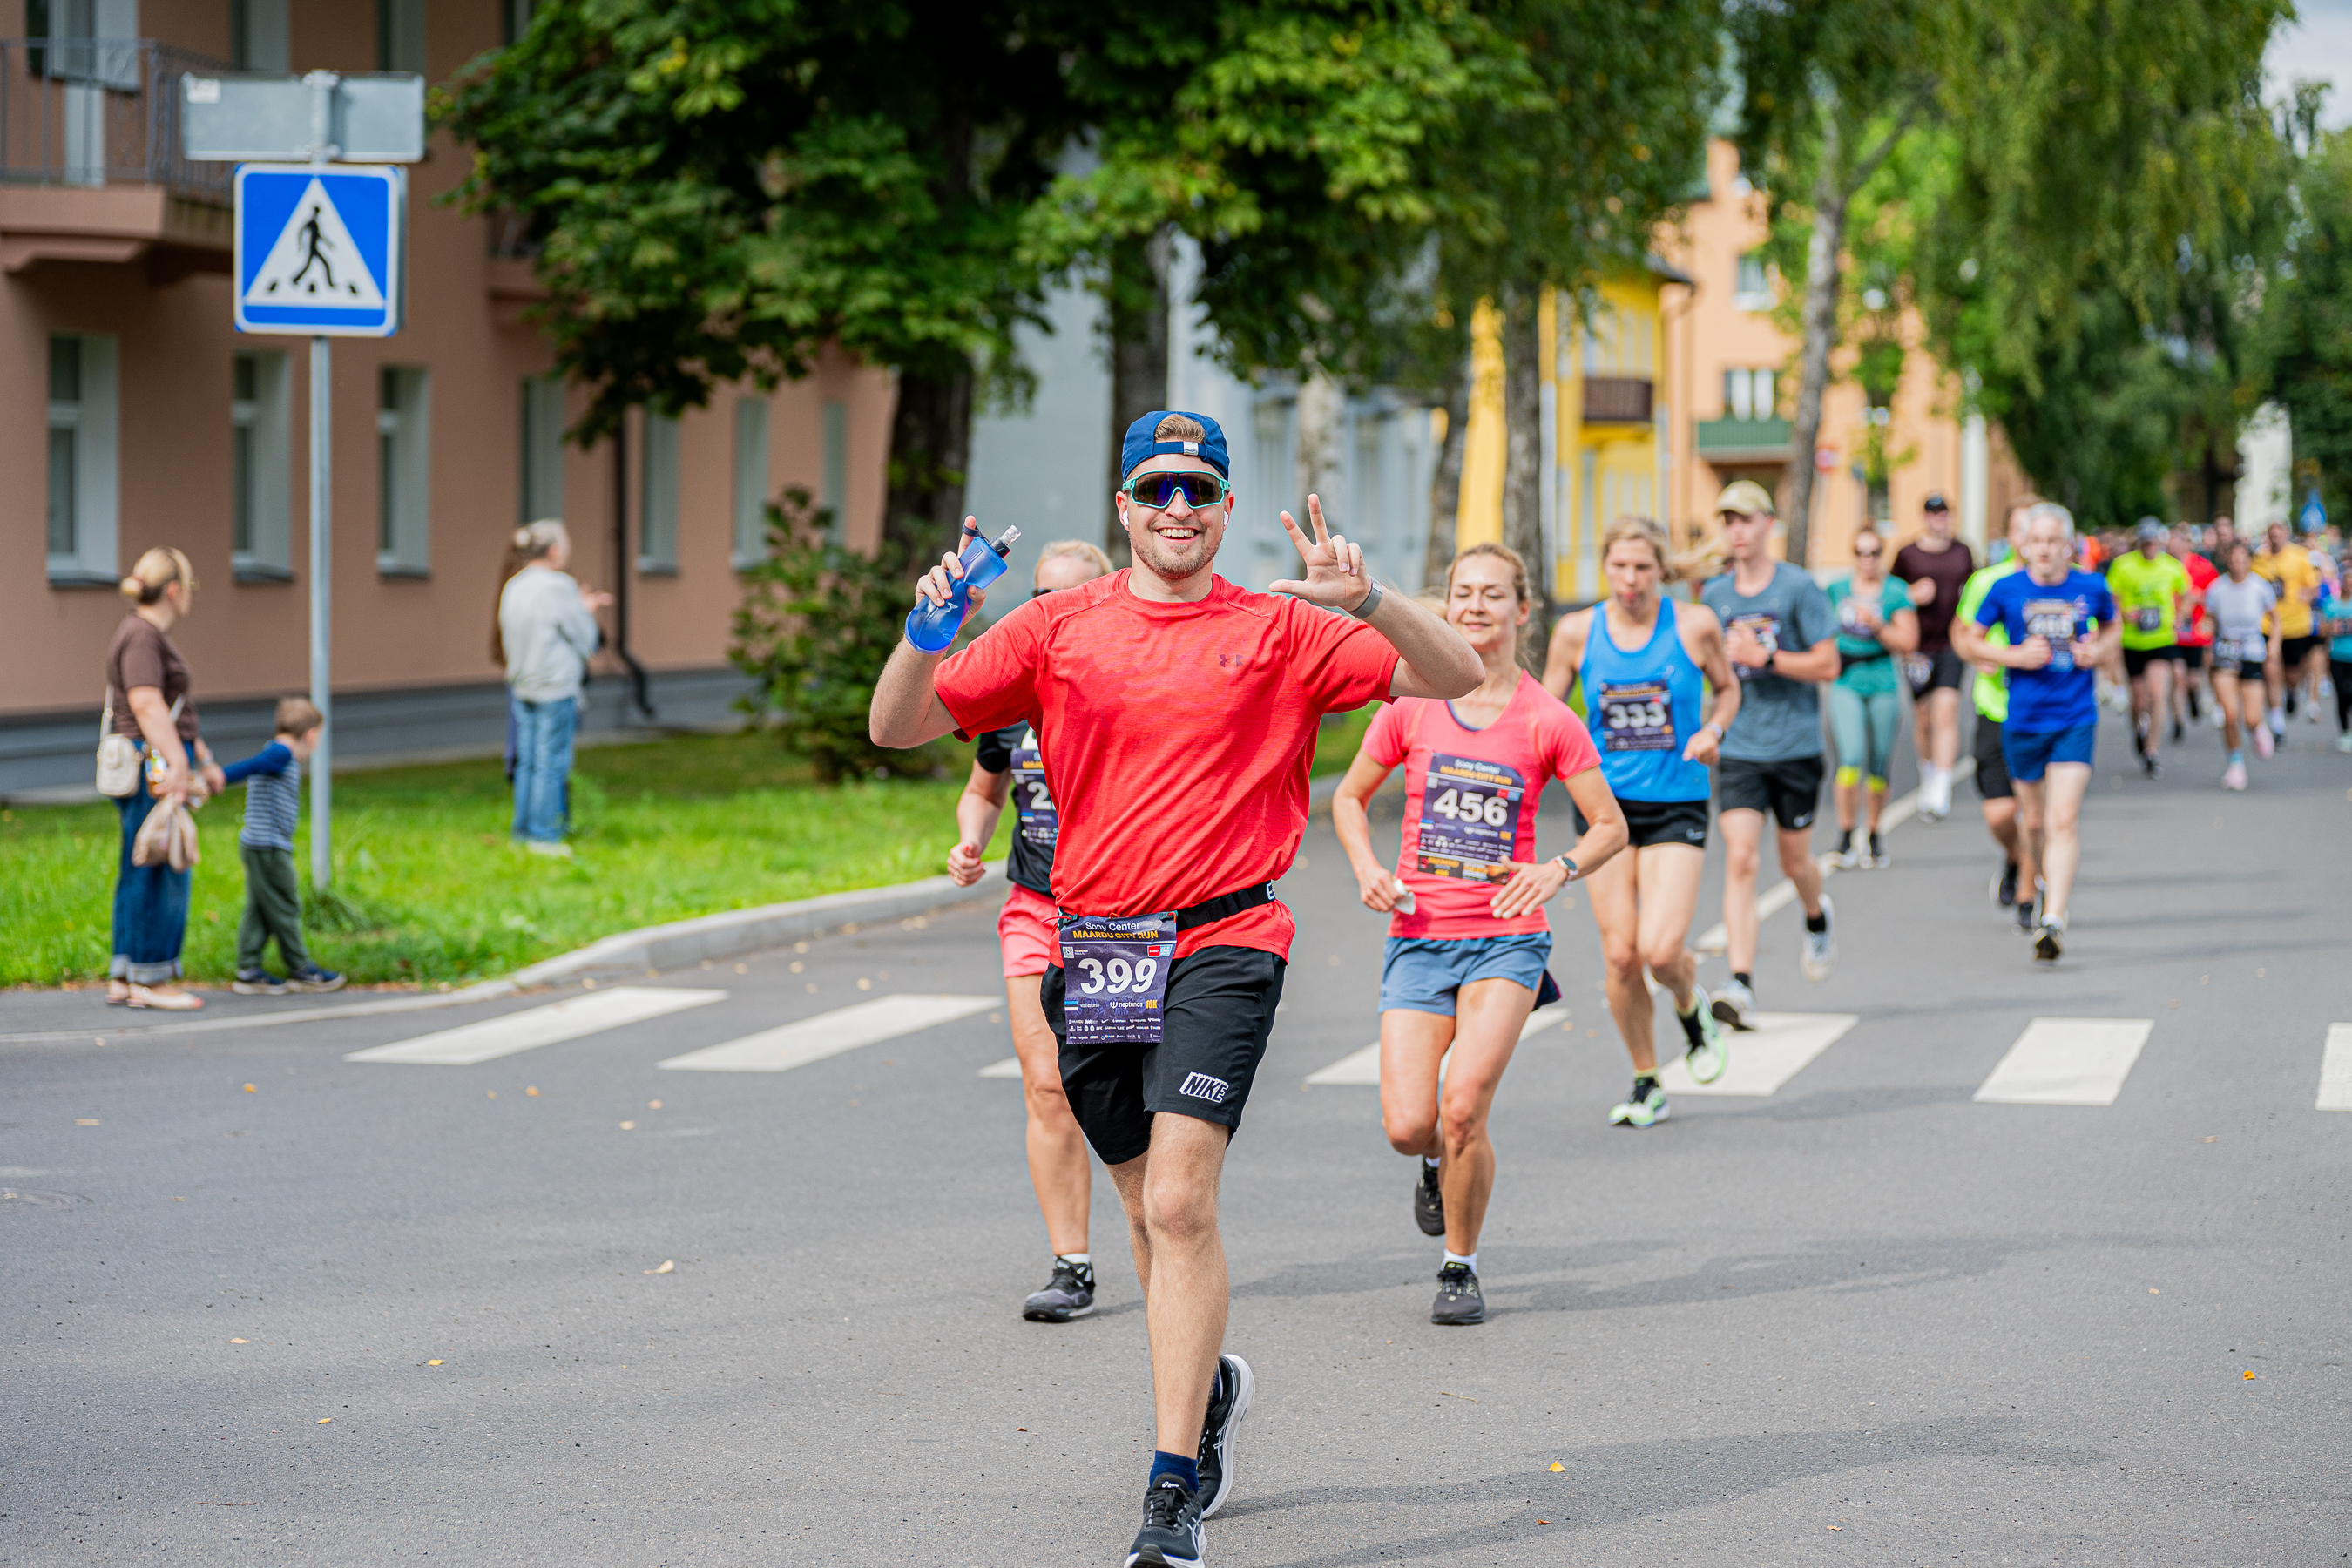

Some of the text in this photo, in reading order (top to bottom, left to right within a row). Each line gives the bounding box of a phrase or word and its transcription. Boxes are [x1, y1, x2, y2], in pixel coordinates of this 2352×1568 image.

[1608, 702, 1667, 729] 333
[1027, 781, 1055, 810] 2
[1432, 788, 1509, 827] 456
[1072, 930, 1114, 939] MAARDU
[1138, 930, 1159, 939] RUN
[1085, 922, 1140, 931] Sony Center
[1078, 958, 1158, 994] 399
[1146, 999, 1158, 1009] 10K
[1179, 1071, 1229, 1103] NIKE
